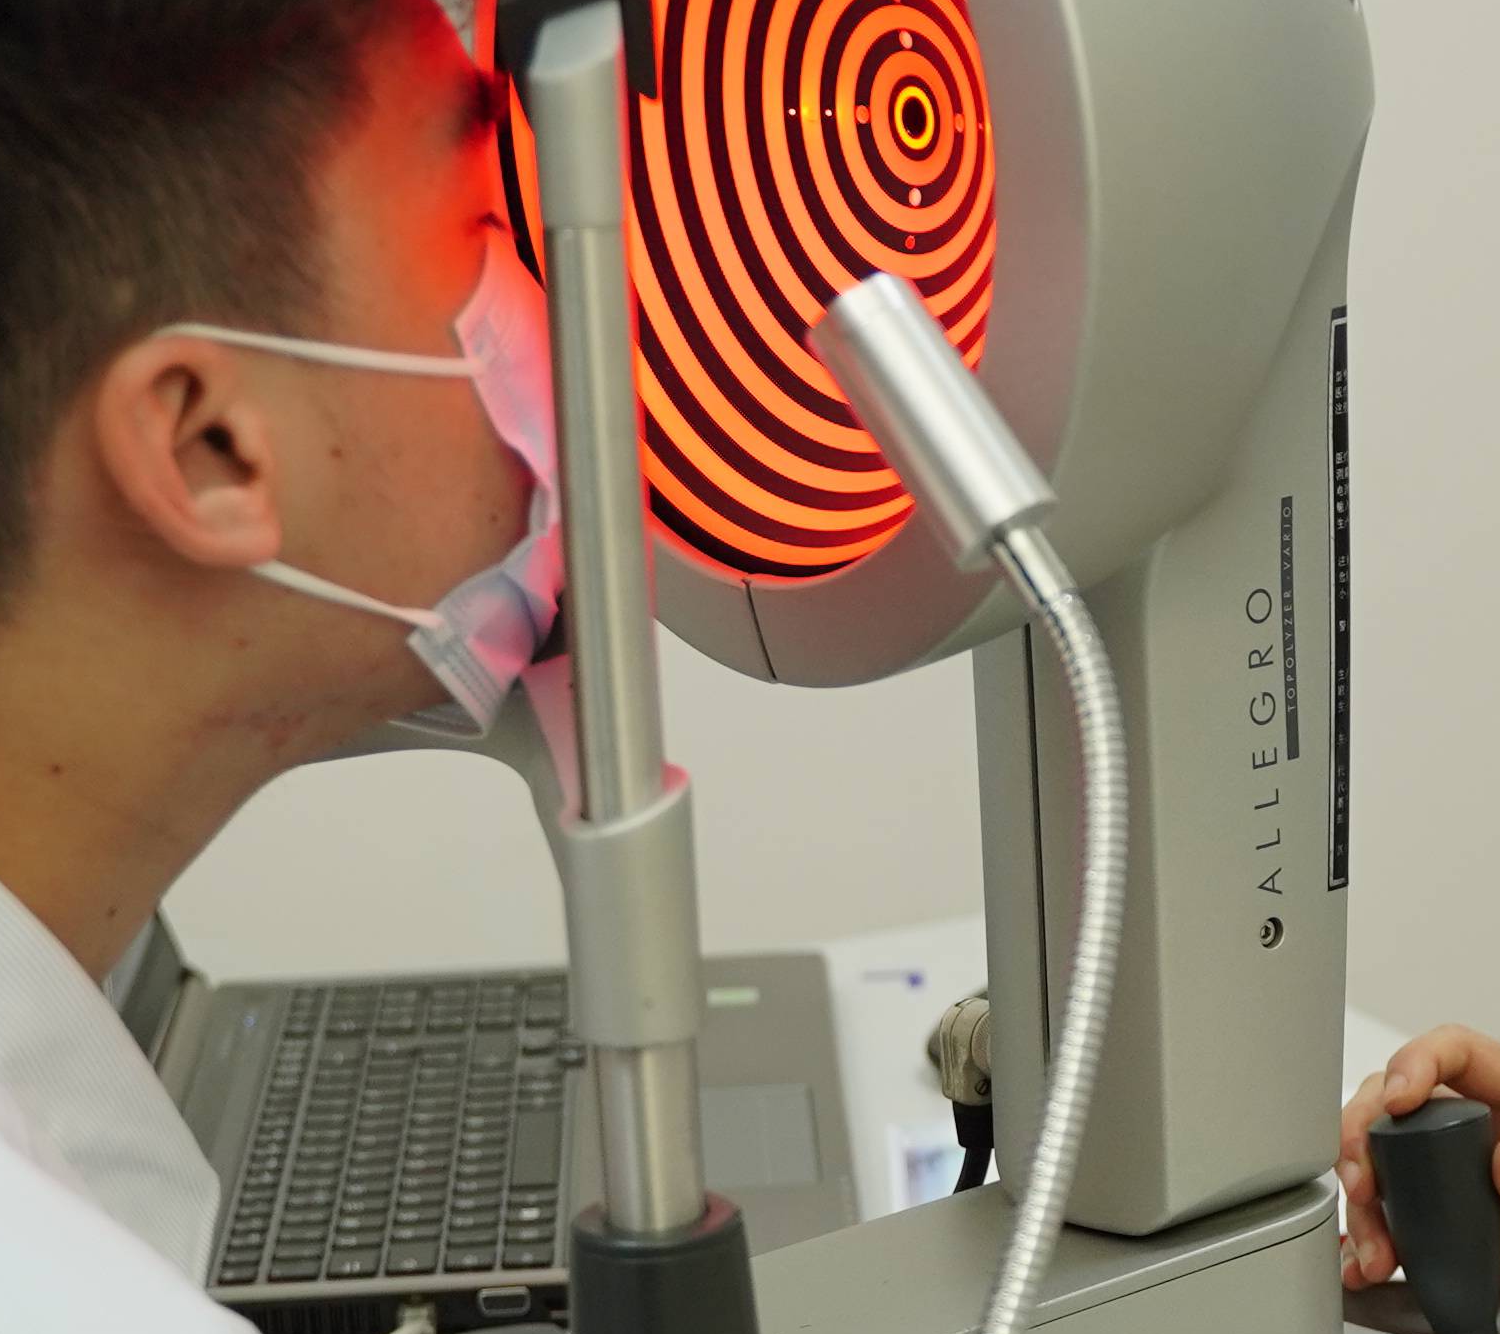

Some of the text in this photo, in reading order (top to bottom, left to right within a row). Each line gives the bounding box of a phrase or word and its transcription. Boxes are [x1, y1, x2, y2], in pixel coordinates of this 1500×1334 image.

[1282, 506, 1296, 713] TOPOLYZER VARIO
[1245, 588, 1283, 895] ALLEGRO
